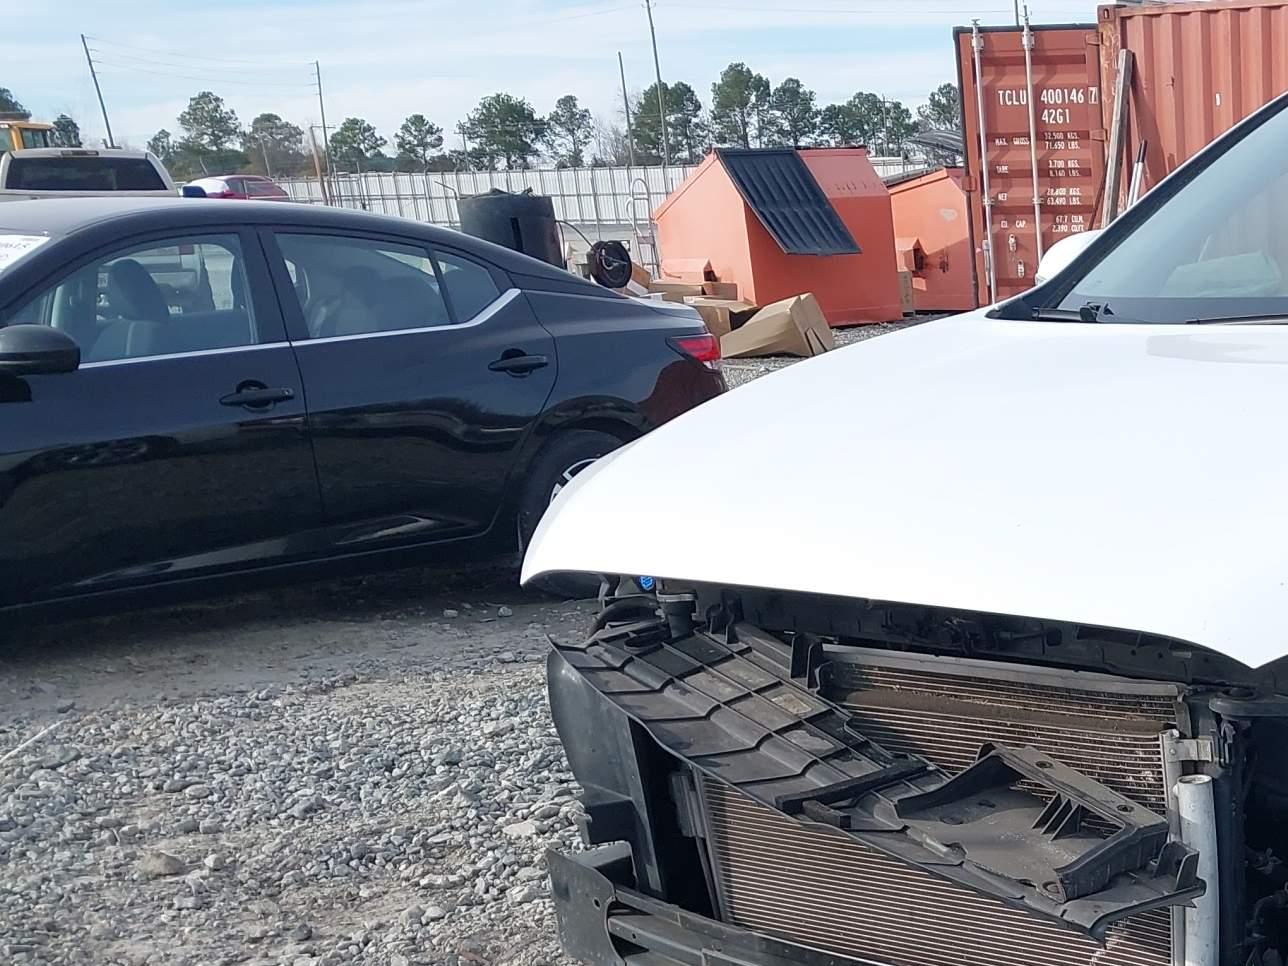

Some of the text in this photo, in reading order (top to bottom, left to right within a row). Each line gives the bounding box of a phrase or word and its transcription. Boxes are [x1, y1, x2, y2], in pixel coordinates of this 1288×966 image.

[998, 87, 1098, 106] TCLU 400146 7
[1041, 108, 1071, 124] 42G1
